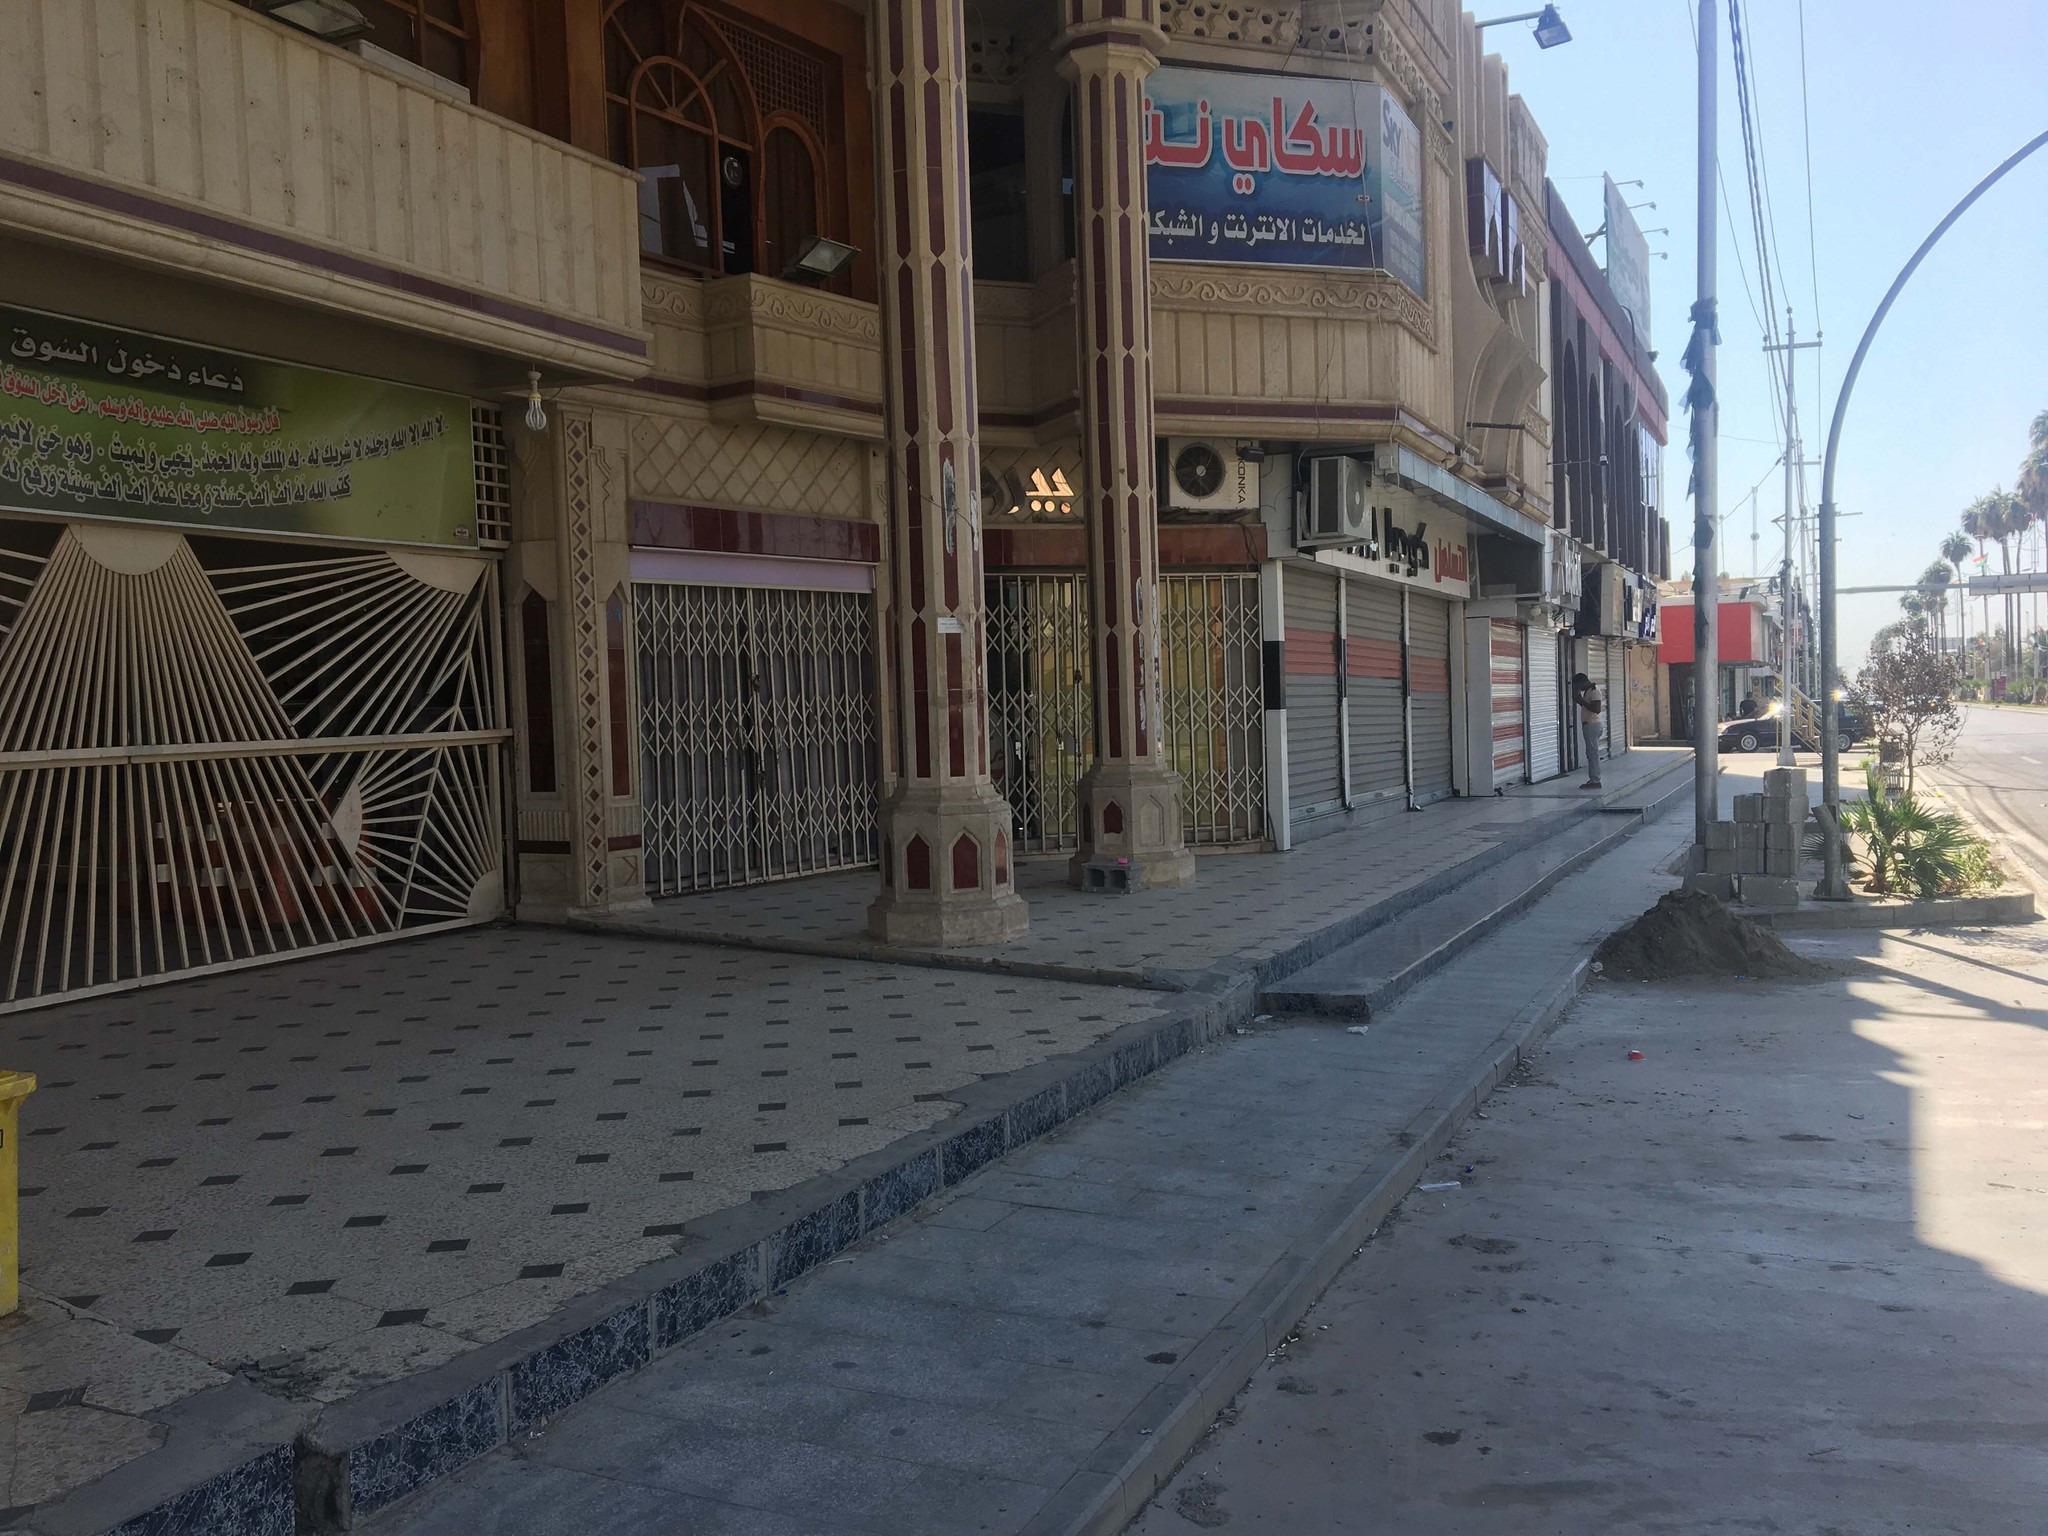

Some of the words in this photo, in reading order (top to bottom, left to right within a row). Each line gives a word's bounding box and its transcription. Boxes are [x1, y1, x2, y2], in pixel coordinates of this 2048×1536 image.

[1222, 97, 1367, 194] سكاي
[1207, 220, 1219, 244] و
[1225, 211, 1297, 246] الانترنت
[1302, 217, 1366, 246] لخدمات
